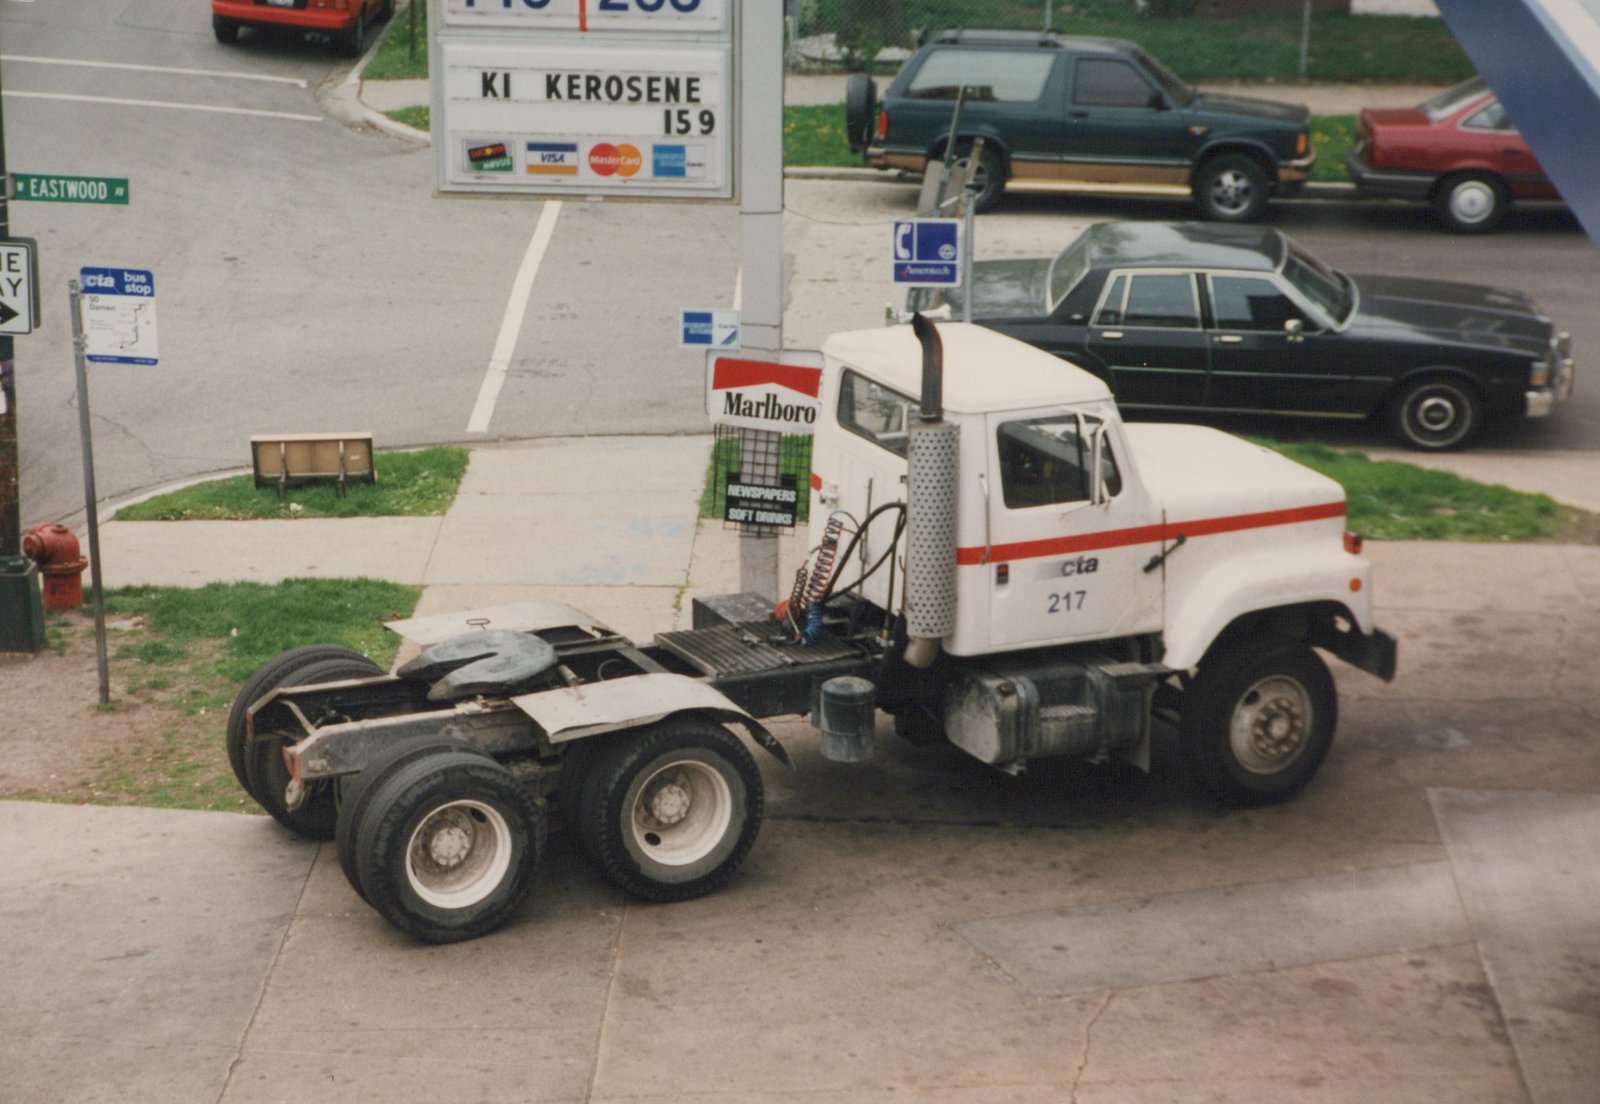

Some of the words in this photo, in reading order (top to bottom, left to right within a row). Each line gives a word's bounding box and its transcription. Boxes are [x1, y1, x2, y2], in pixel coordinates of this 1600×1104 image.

[545, 74, 701, 103] KEROSENE
[541, 153, 565, 163] VISA
[590, 155, 641, 166] MasterCard
[30, 178, 108, 199] EASTWOOD
[86, 274, 115, 288] cta
[124, 271, 147, 284] bus
[125, 283, 152, 295] stop
[723, 391, 816, 424] Marlboro
[727, 484, 796, 503] NEWSPAPERS
[728, 508, 753, 522] SOFT
[755, 510, 793, 525] DRINKS
[1060, 556, 1098, 577] cta
[1047, 590, 1087, 613] 217
